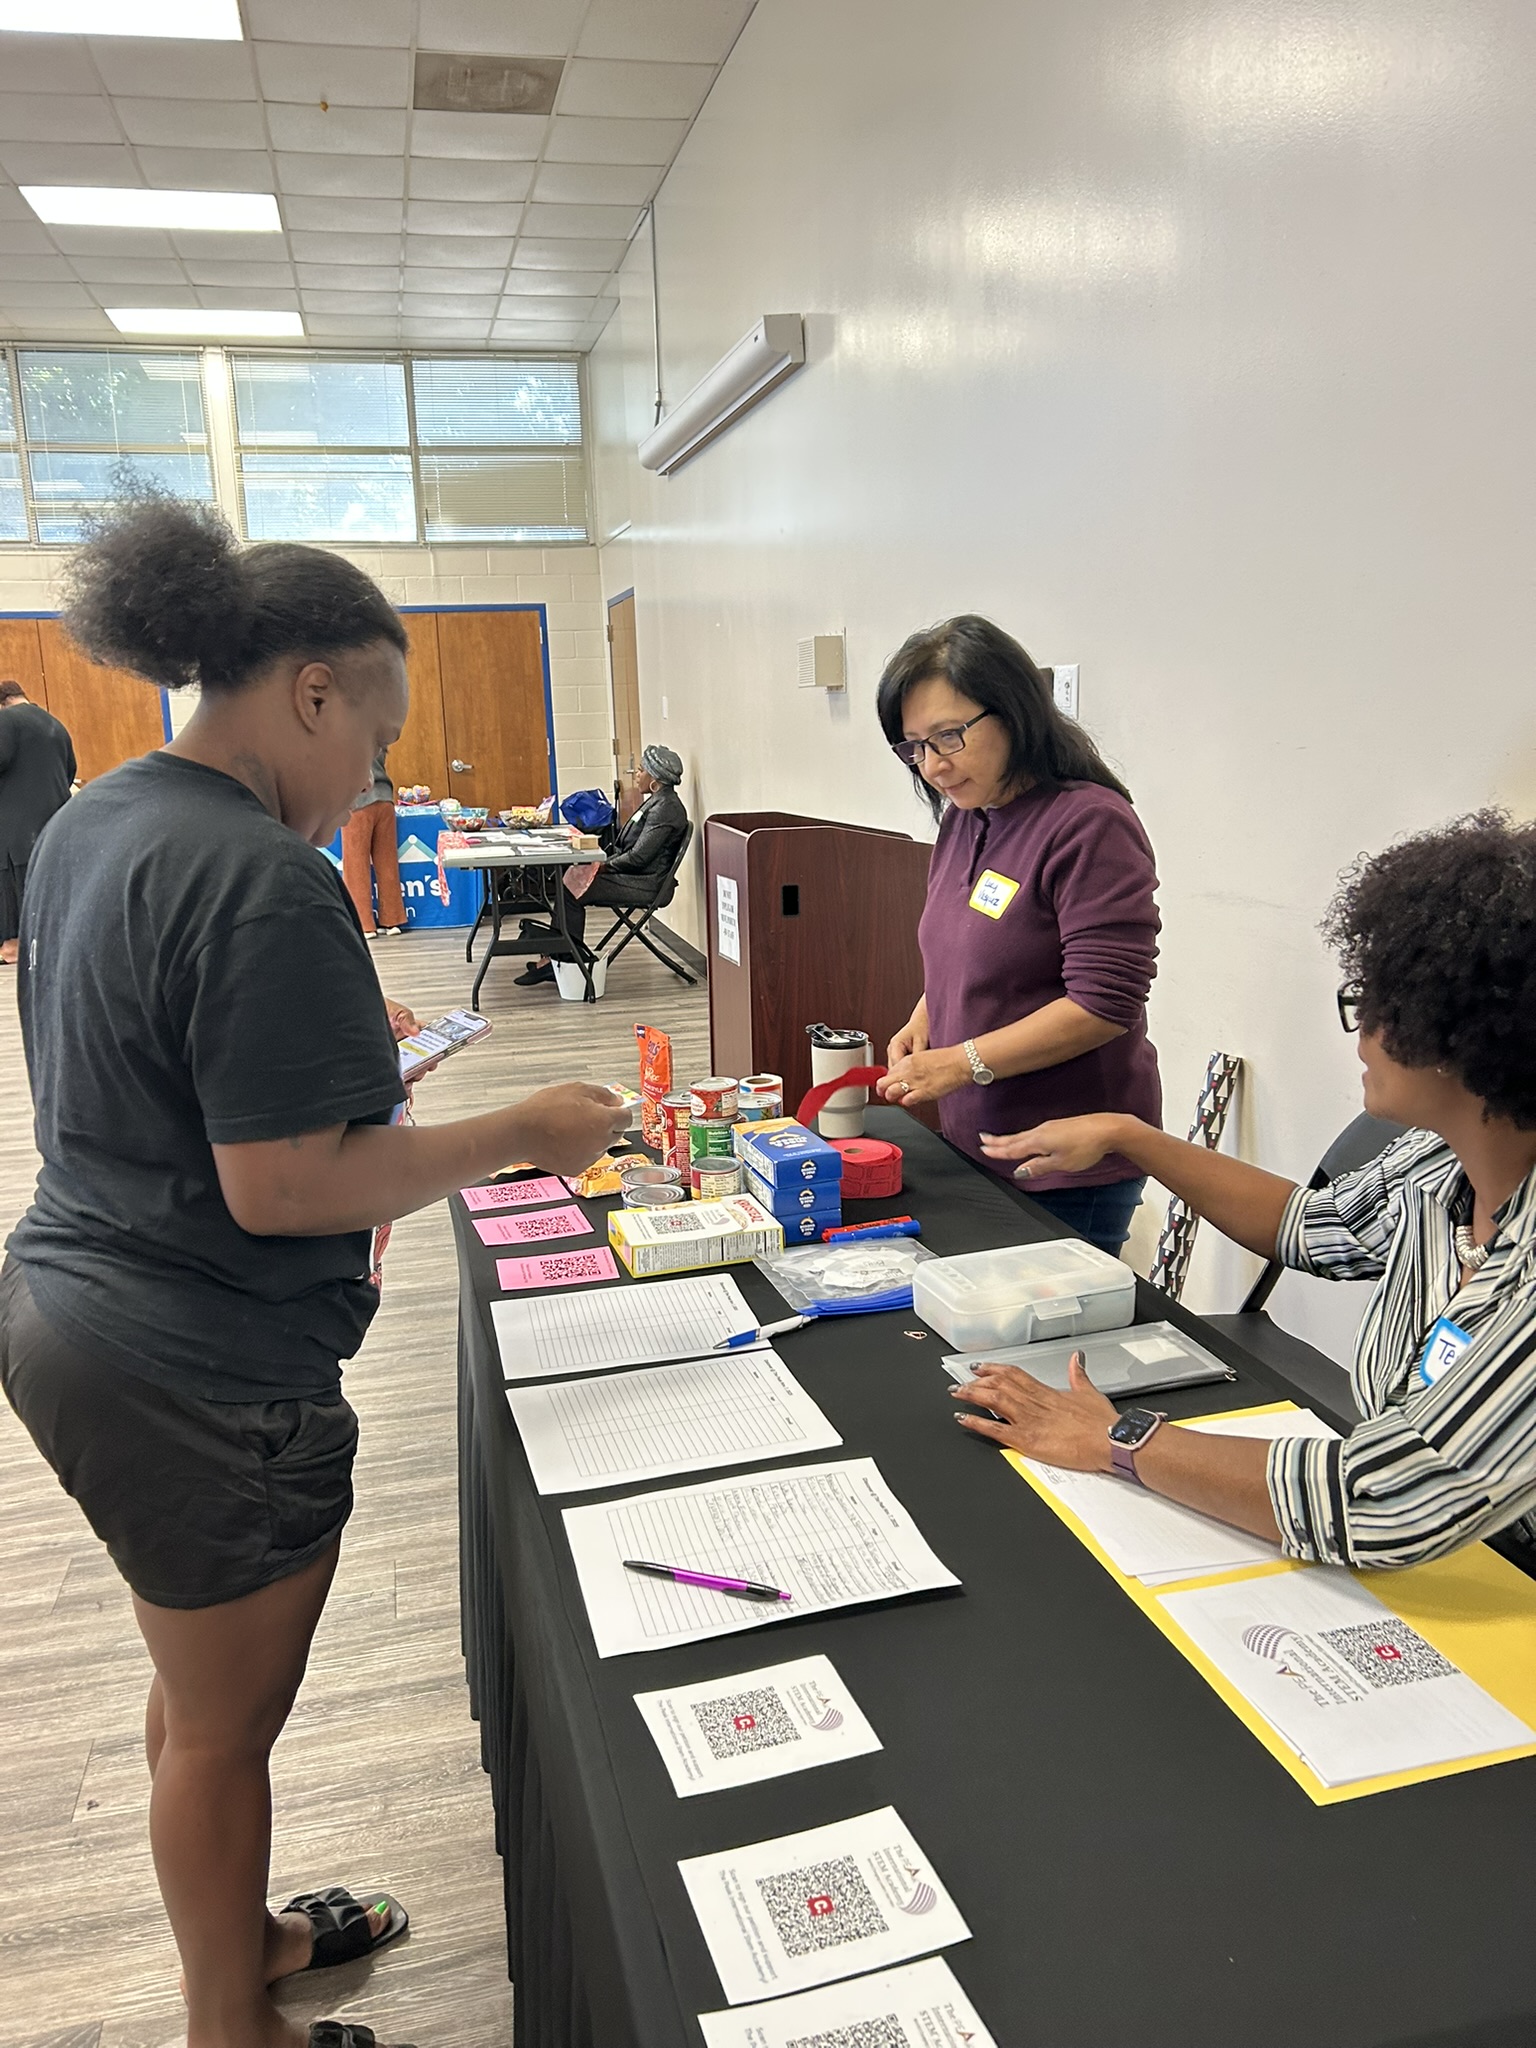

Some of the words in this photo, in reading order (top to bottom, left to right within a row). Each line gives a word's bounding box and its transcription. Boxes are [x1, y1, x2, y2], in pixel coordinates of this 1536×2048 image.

[1439, 1338, 1460, 1365] Te
[1290, 1635, 1334, 1674] Academy
[809, 1680, 817, 1691] The
[1283, 1649, 1348, 1705] International
[1329, 1674, 1364, 1701] STEM
[791, 1685, 804, 1701] STEM
[1309, 1689, 1330, 1707] The
[893, 1845, 904, 1858] The
[873, 1851, 889, 1873] STEM
[885, 1874, 905, 1905] Academy
[883, 1847, 912, 1893] International
[722, 1880, 733, 1895] Peak
[728, 1896, 747, 1933] International
[728, 1868, 740, 1883] Scan
[756, 1940, 767, 1953] and
[920, 2010, 940, 2036] STEM
[944, 2002, 956, 2019] The
